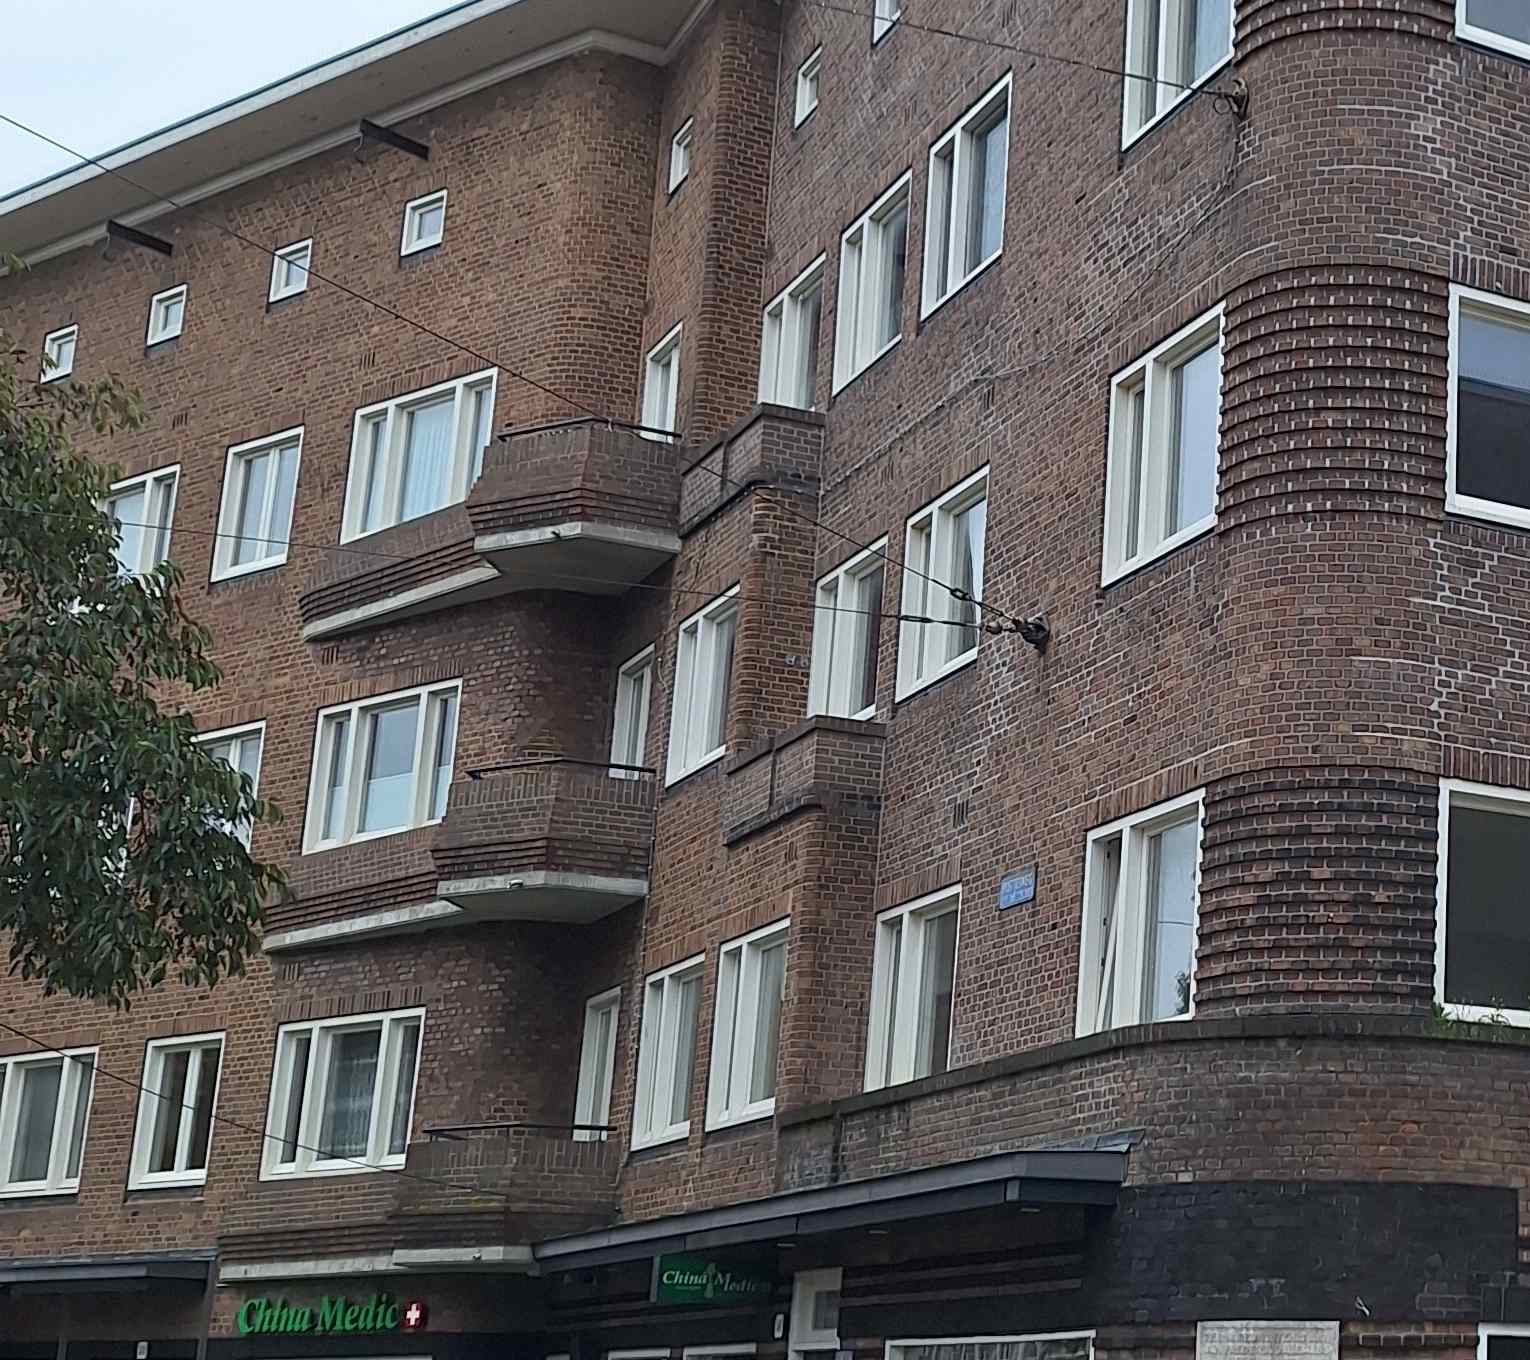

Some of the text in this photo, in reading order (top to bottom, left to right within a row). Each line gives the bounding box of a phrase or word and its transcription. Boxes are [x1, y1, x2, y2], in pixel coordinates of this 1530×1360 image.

[662, 1270, 707, 1285] China
[239, 1293, 399, 1333] China Medic
